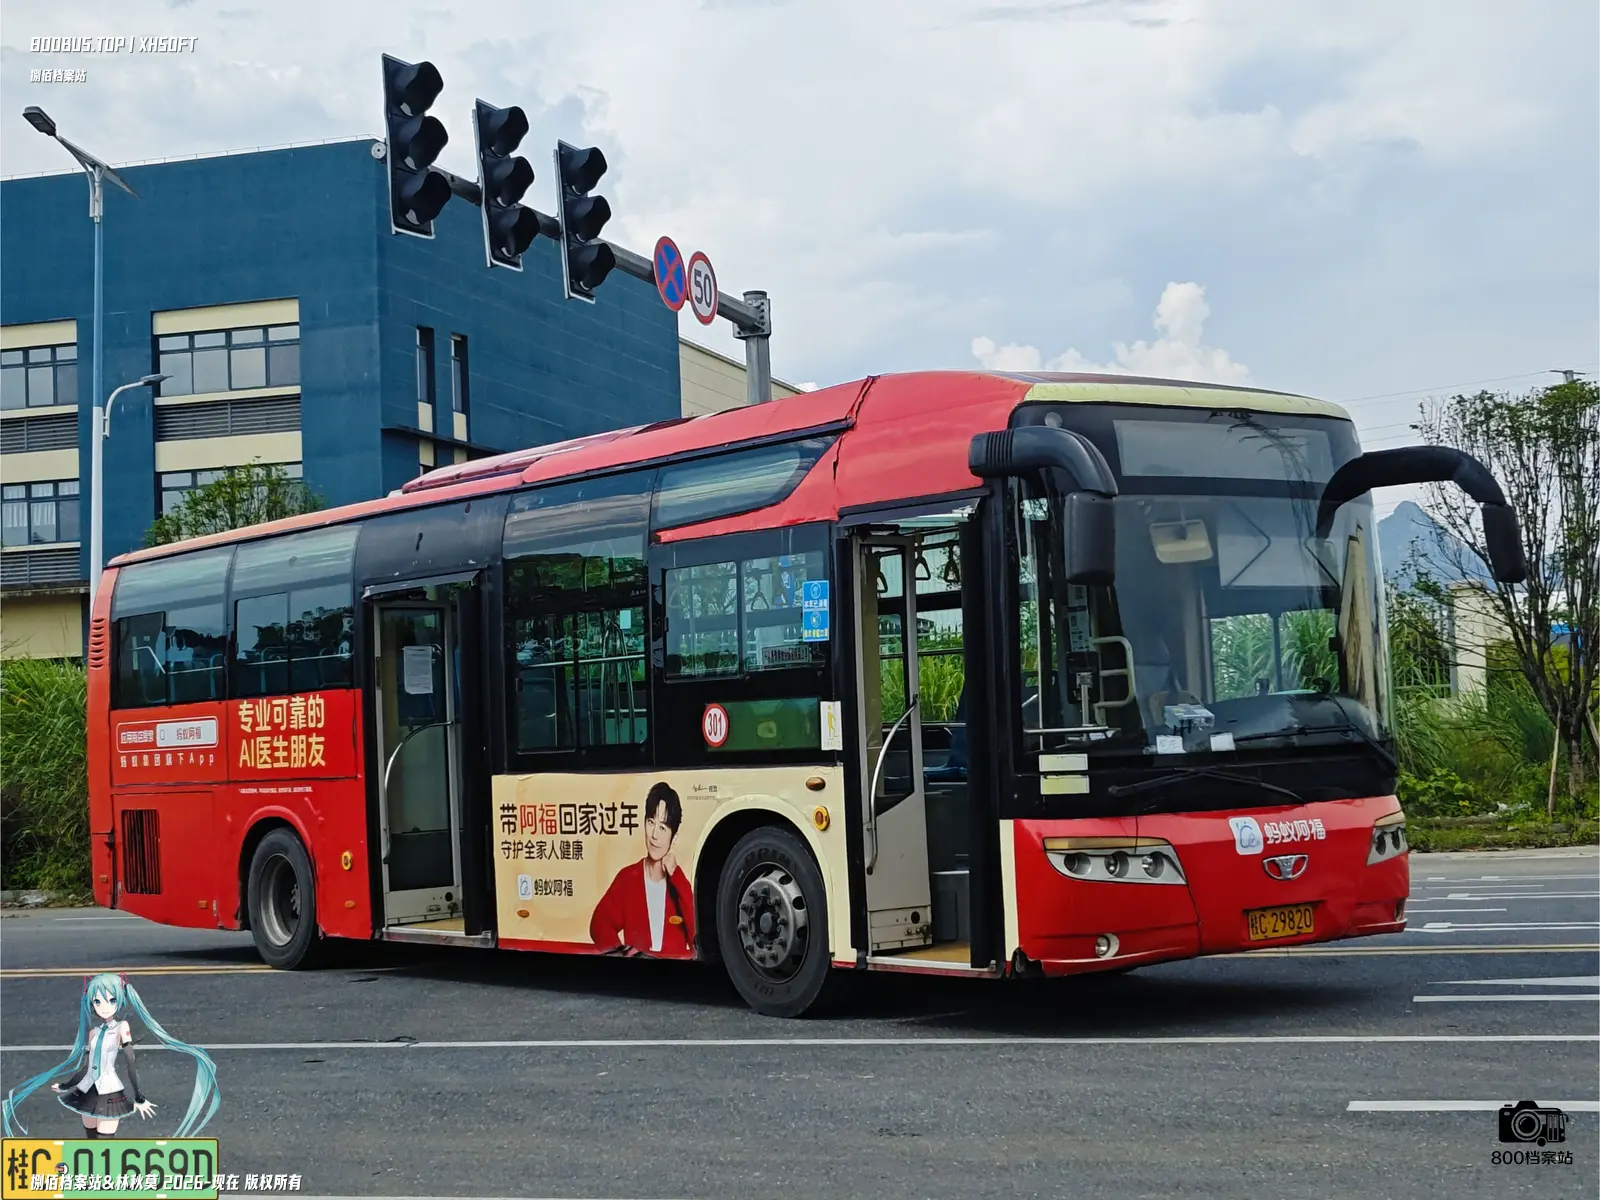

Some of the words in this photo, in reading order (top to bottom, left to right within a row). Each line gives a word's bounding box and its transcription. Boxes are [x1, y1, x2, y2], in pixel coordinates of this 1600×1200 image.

[694, 268, 712, 308] 50
[238, 695, 325, 733] 专业可靠的
[708, 713, 722, 737] 301
[176, 727, 202, 741] 蚂蚁阿福
[239, 733, 326, 769] AI医生朋友
[499, 802, 639, 836] 带阿福回家过年
[1264, 818, 1326, 845] 蚂蚁阿福
[500, 839, 584, 861] 守护全家人健康
[534, 879, 574, 897] 蚂蚁阿福
